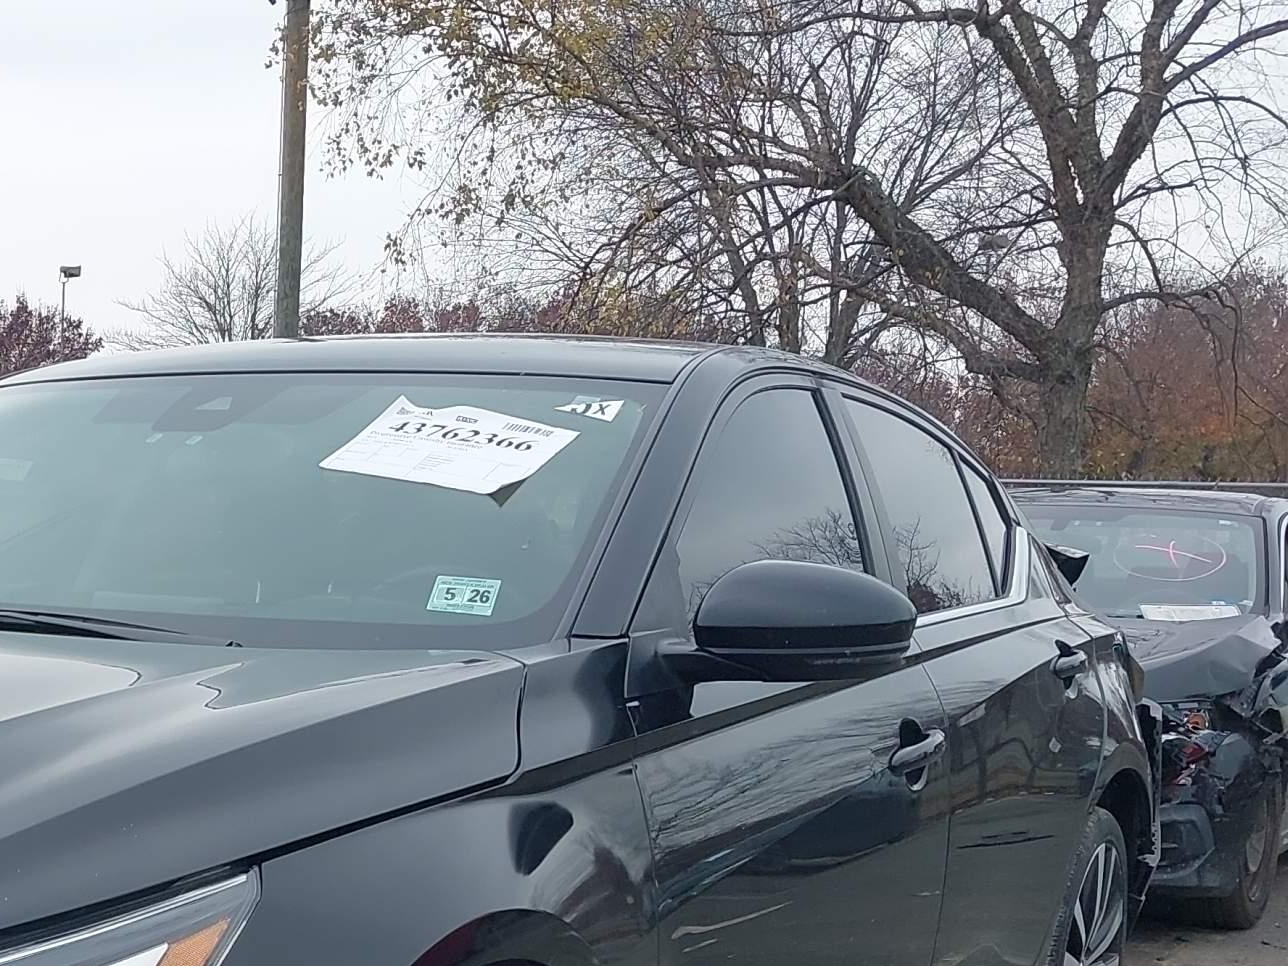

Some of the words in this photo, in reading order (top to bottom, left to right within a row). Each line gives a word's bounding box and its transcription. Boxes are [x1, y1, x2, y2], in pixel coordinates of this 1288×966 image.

[388, 421, 540, 452] 43762366
[443, 587, 457, 601] 5
[466, 588, 492, 604] 26
